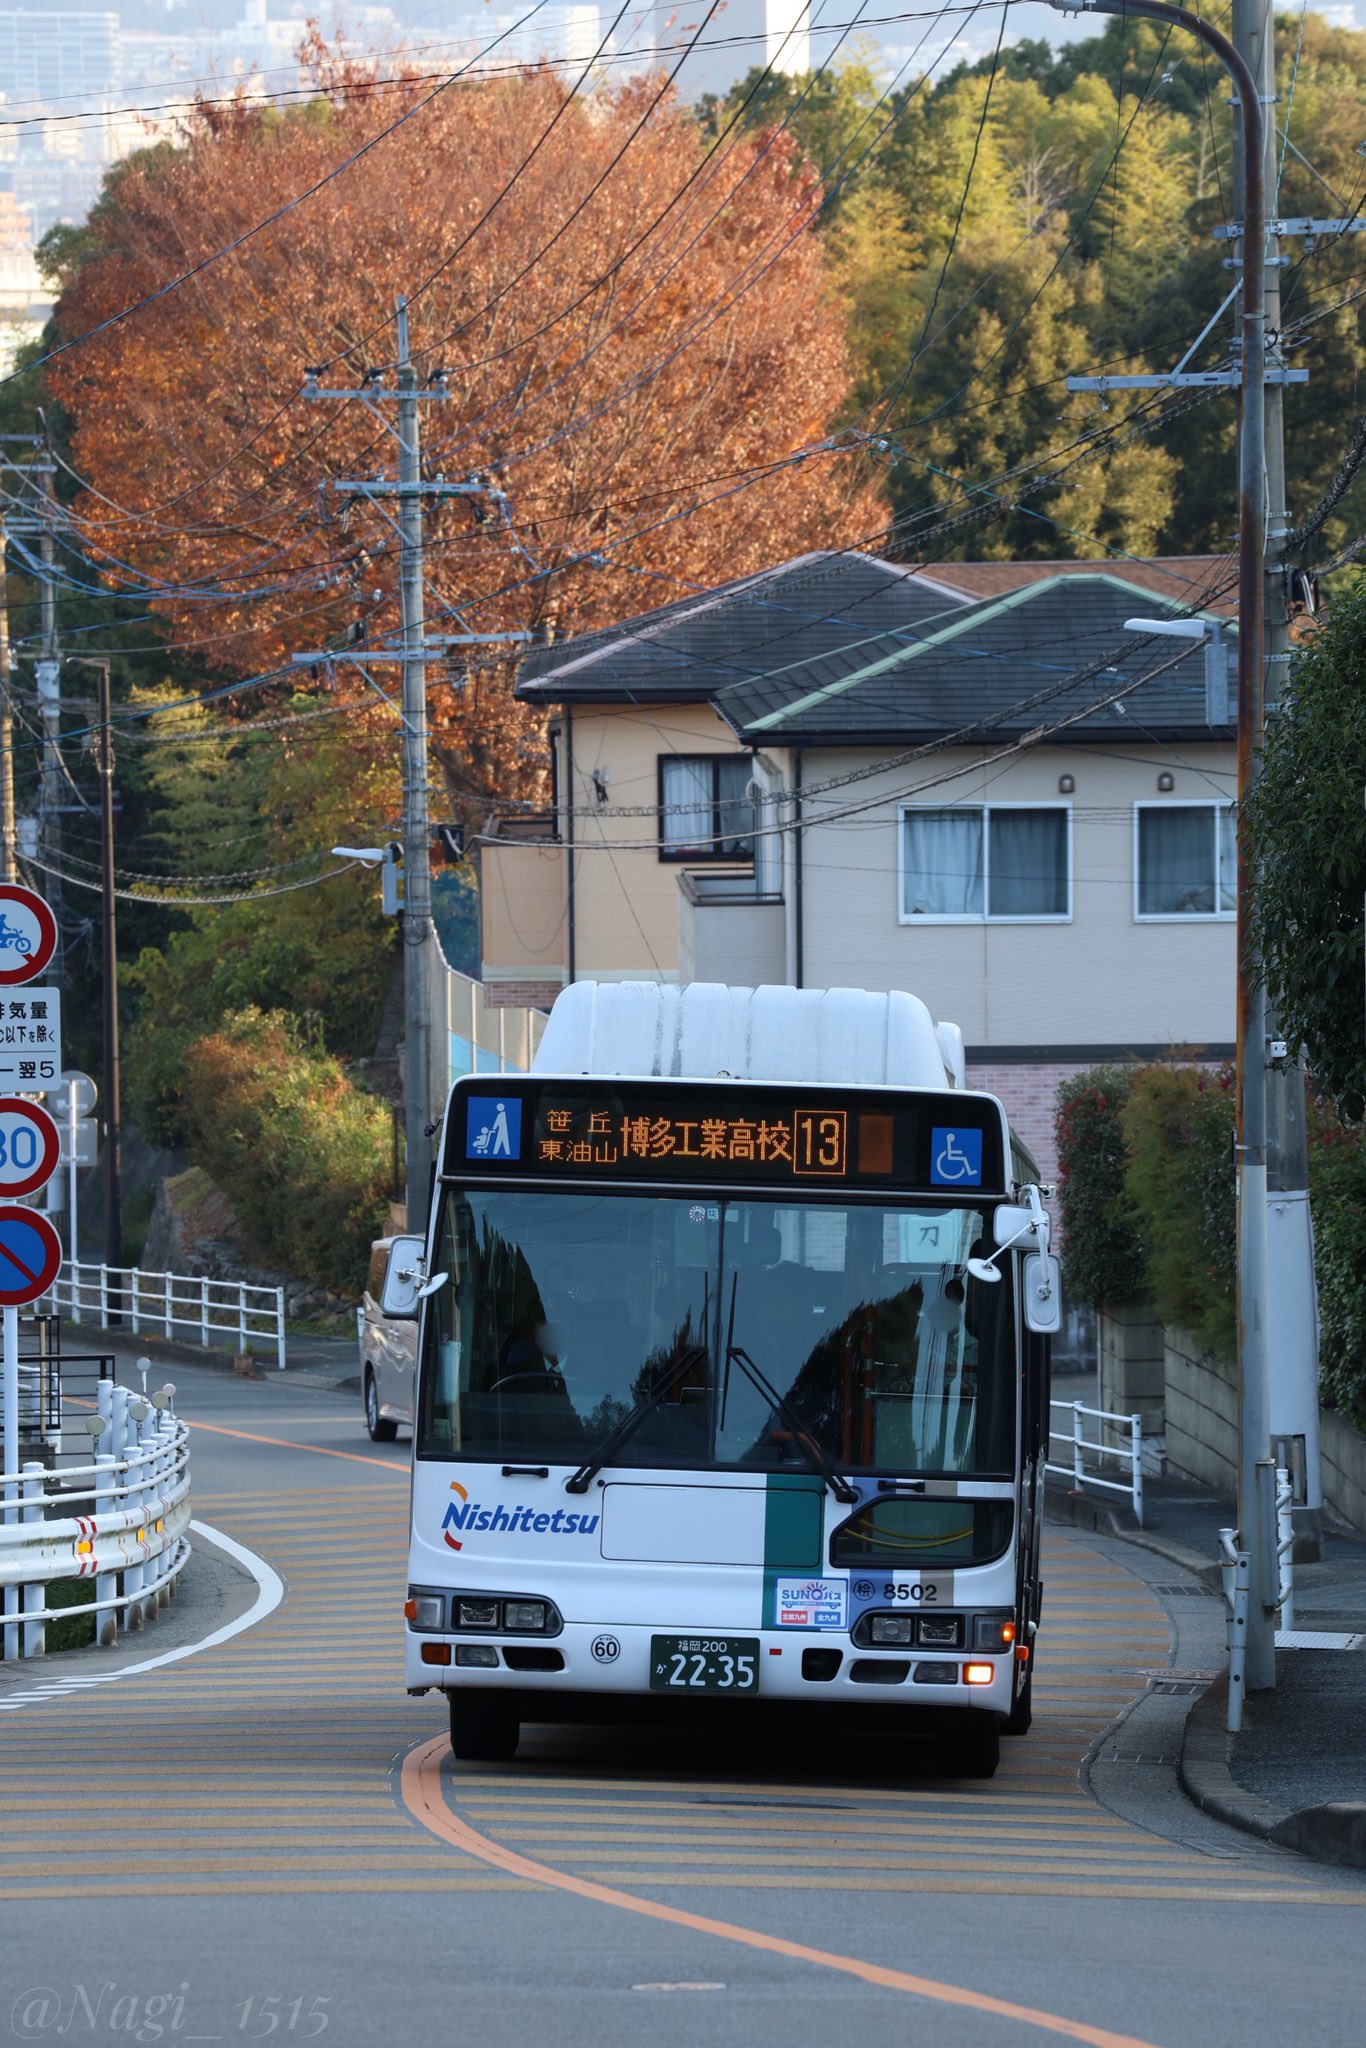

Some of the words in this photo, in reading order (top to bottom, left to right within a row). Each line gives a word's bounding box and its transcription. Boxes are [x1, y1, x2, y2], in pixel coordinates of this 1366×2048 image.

[539, 1140, 617, 1163] 東油山
[620, 1117, 793, 1160] 博多工業高校
[801, 1118, 840, 1166] 13
[441, 1501, 600, 1535] Nishitetsu
[883, 1583, 937, 1601] 8502
[595, 1641, 617, 1657] 60
[655, 1663, 667, 1675] か
[669, 1654, 754, 1688] 22-35
